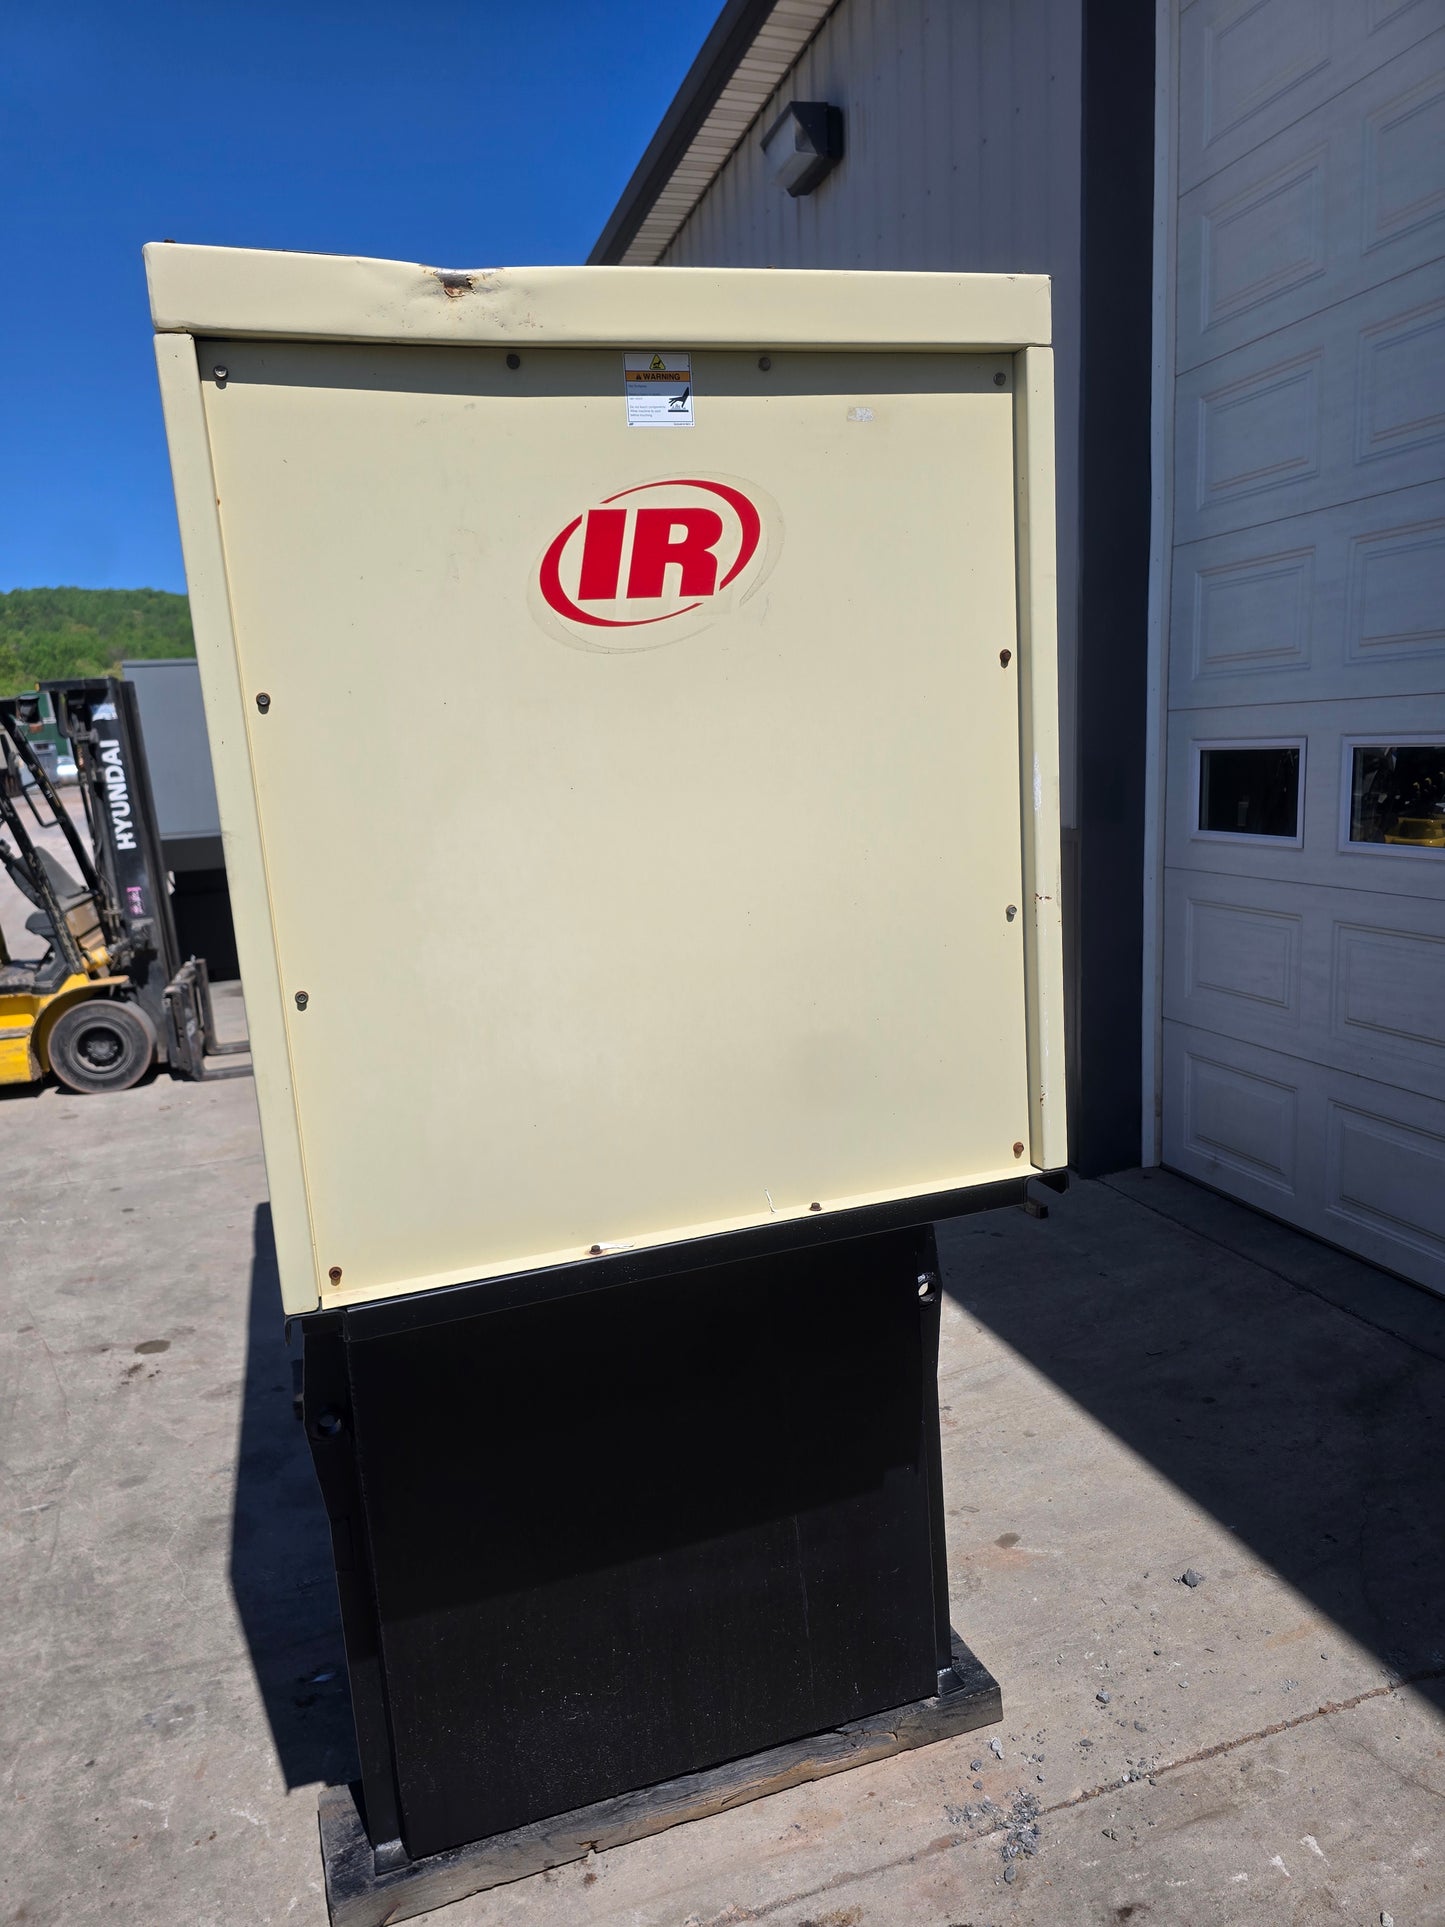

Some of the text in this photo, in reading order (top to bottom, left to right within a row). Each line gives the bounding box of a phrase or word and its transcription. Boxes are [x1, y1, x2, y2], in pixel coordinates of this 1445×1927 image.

[643, 372, 681, 381] WARNING
[577, 507, 723, 601] IR
[99, 739, 137, 850] HYUNDAI
